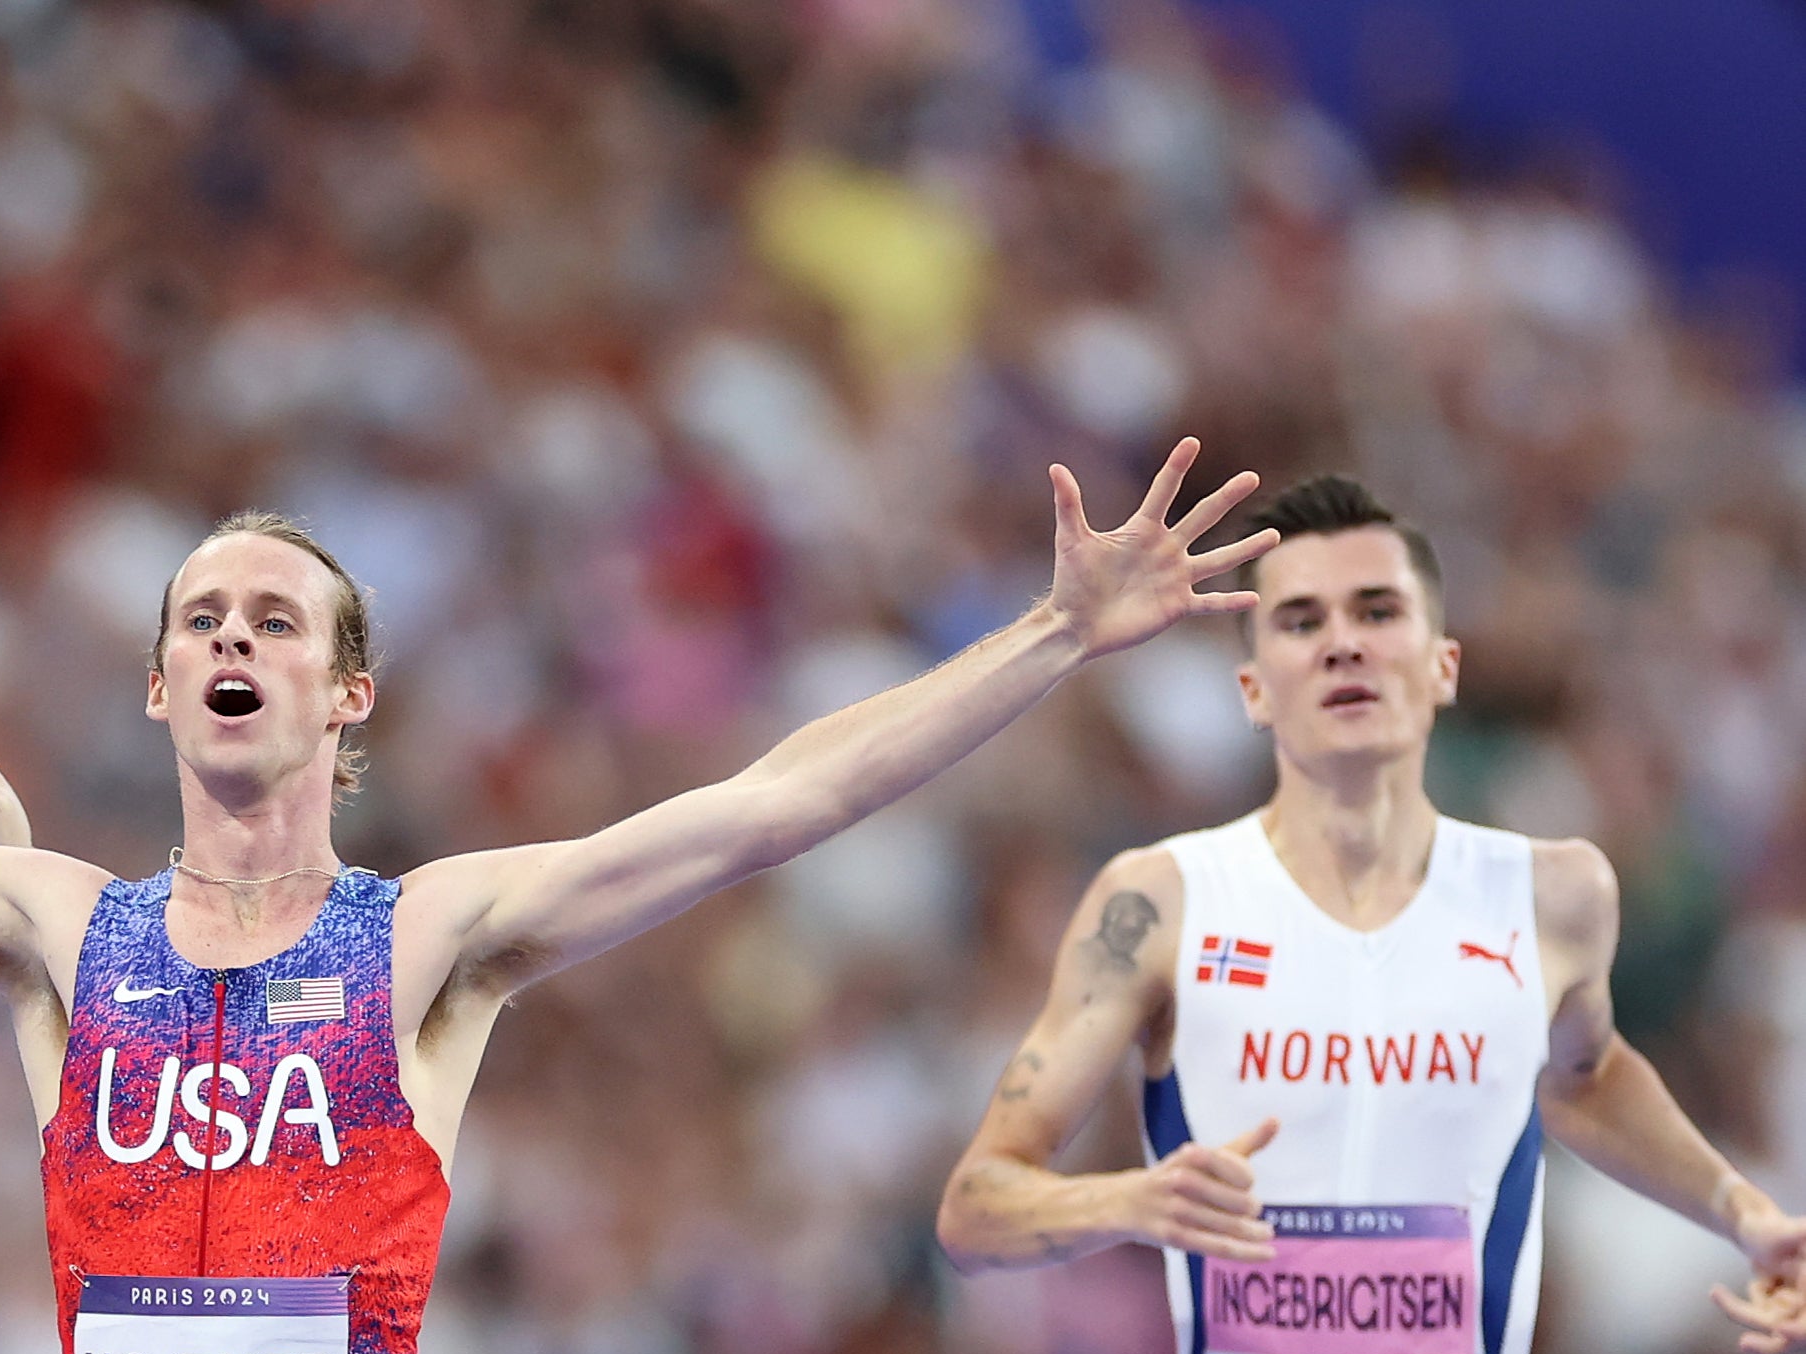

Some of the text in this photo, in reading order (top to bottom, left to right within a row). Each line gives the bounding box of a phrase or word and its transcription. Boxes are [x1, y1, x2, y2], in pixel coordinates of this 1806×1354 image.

[1239, 1030, 1485, 1085] NORWAY
[96, 1046, 341, 1171] USA
[131, 1287, 271, 1306] PARIS 2024
[1212, 1269, 1464, 1331] INGEBRIGTSEN
